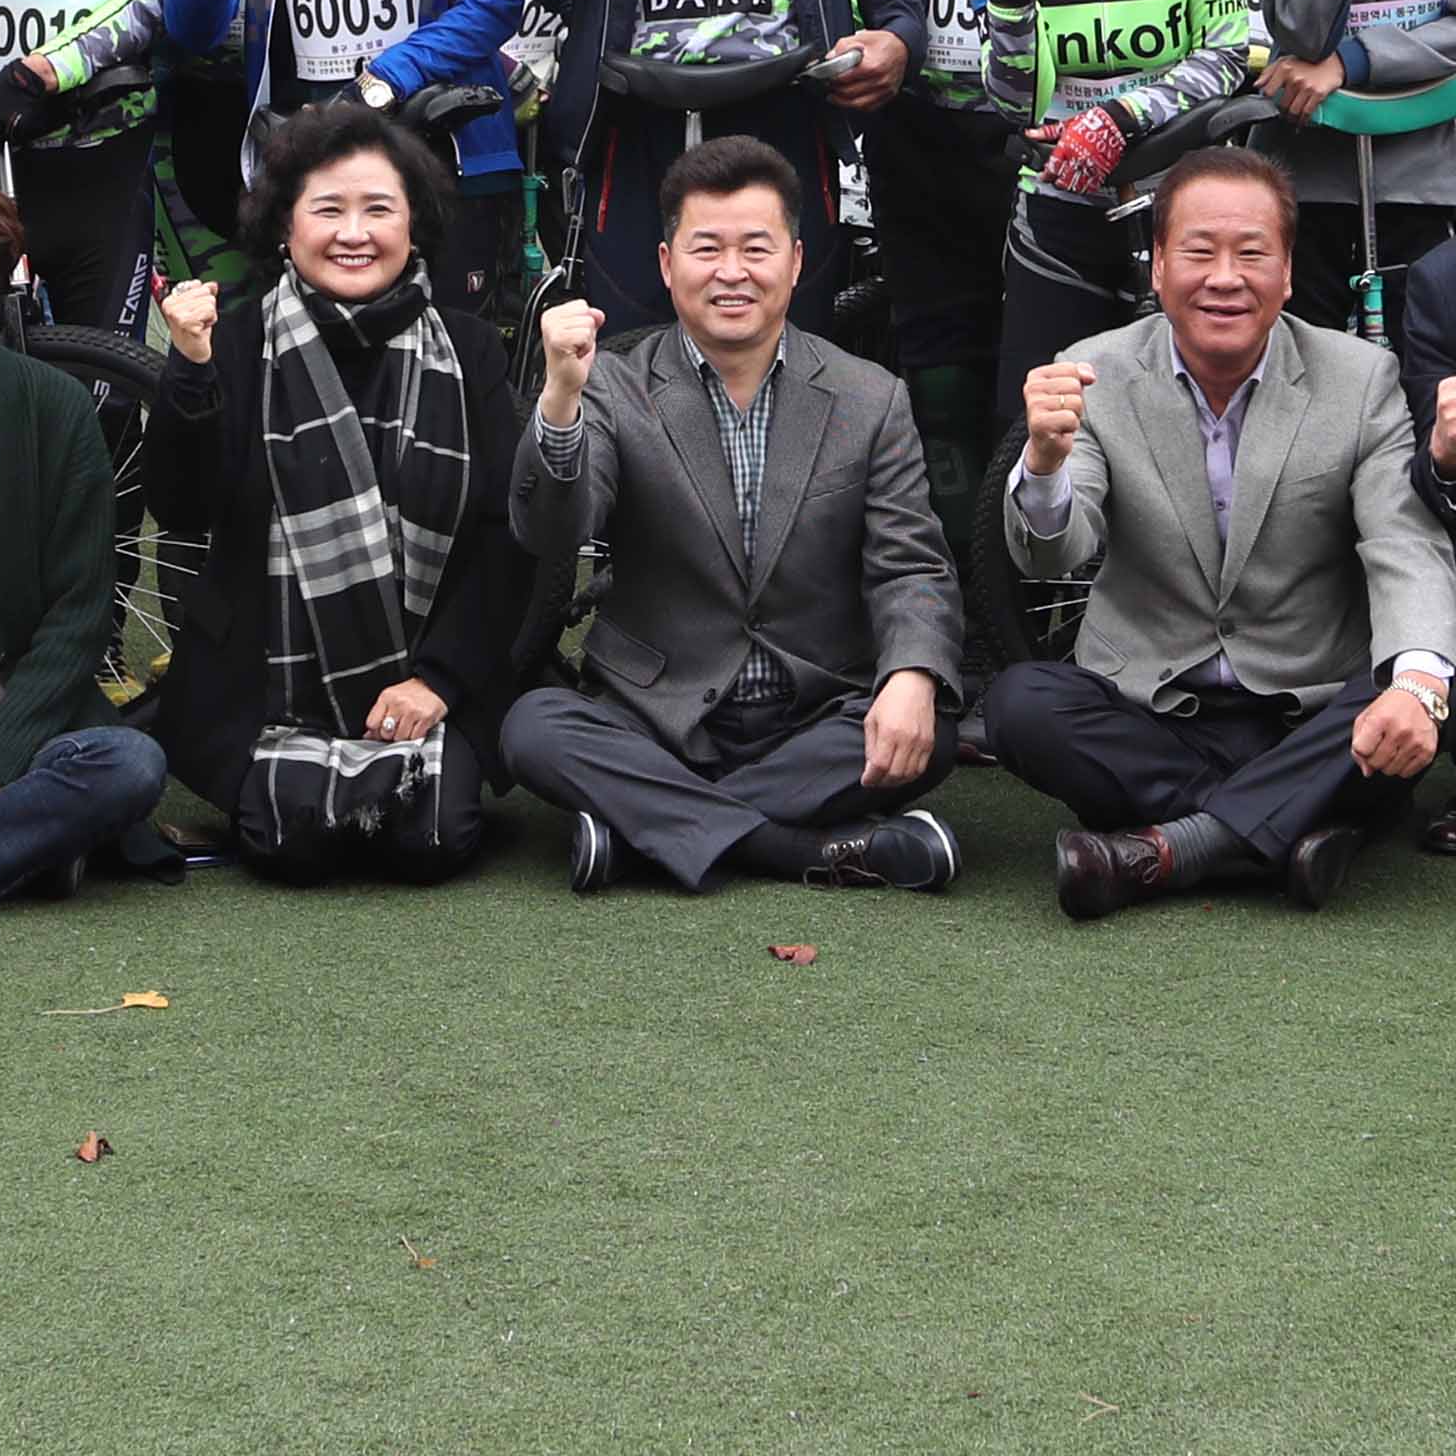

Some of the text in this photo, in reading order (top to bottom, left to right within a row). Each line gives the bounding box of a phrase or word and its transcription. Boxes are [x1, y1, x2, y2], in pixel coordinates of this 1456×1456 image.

[1347, 7, 1392, 22] 천광역시
[1044, 1, 1193, 65] nkof
[1118, 73, 1166, 91] 동구청장
